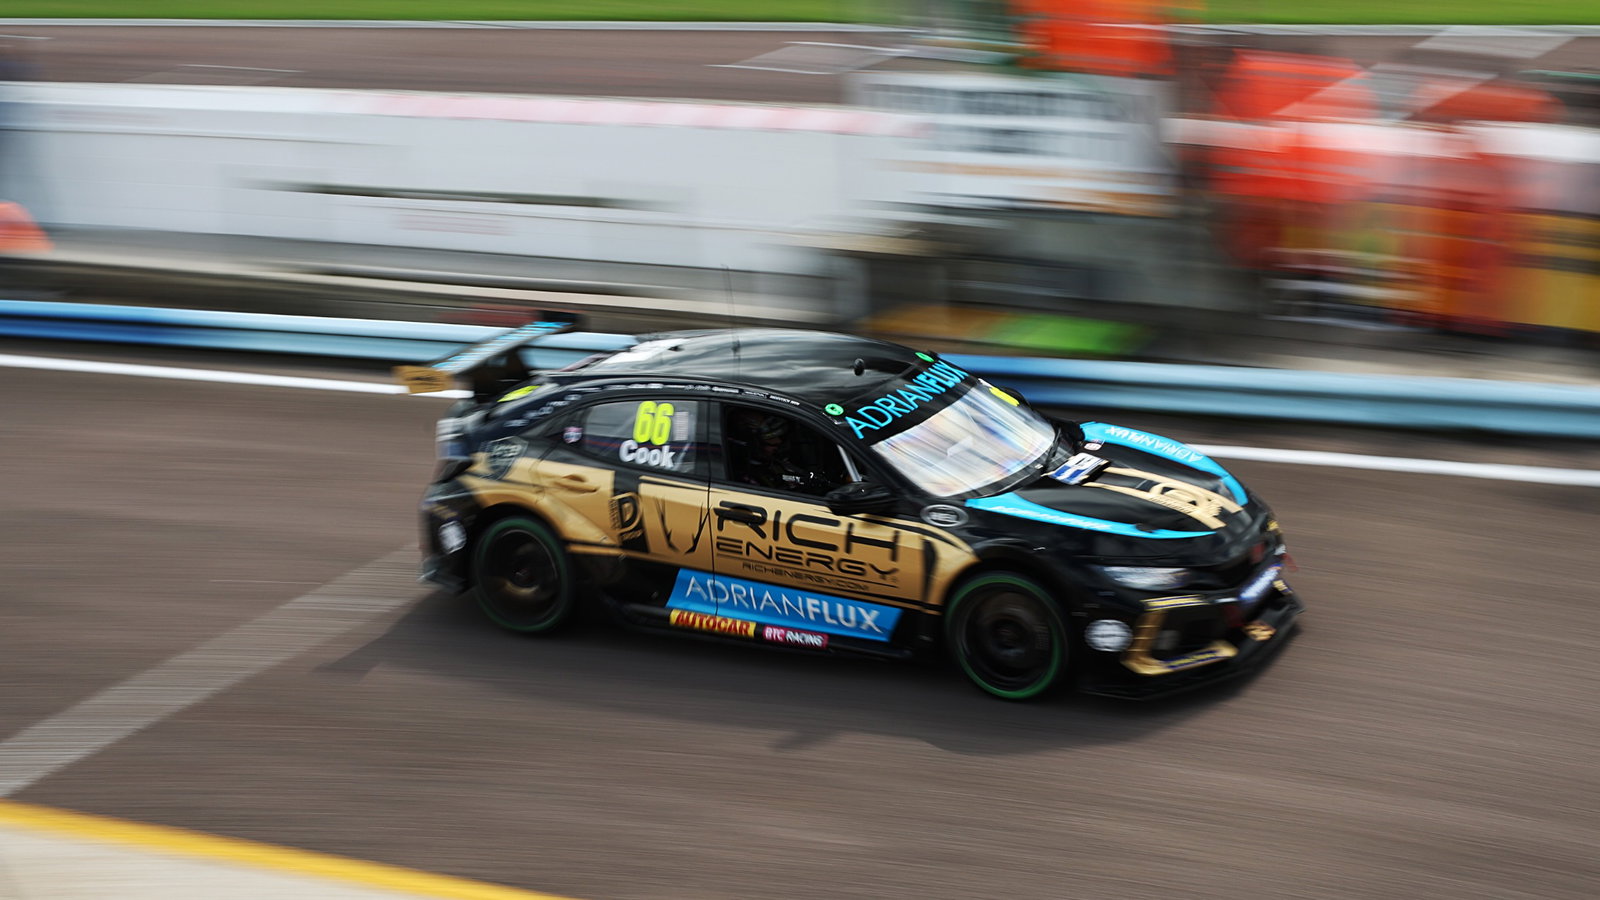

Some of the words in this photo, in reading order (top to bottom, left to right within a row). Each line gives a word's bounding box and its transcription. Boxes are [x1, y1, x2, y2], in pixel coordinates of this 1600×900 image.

[845, 360, 969, 439] ADRIANFLUX
[632, 400, 674, 446] 66
[619, 439, 676, 469] Cook
[713, 500, 900, 562] RICH
[716, 536, 900, 581] ENERGY
[675, 611, 750, 636] AUTOCAR
[685, 576, 883, 634] ADRIANFLUX
[786, 629, 825, 647] RACING
